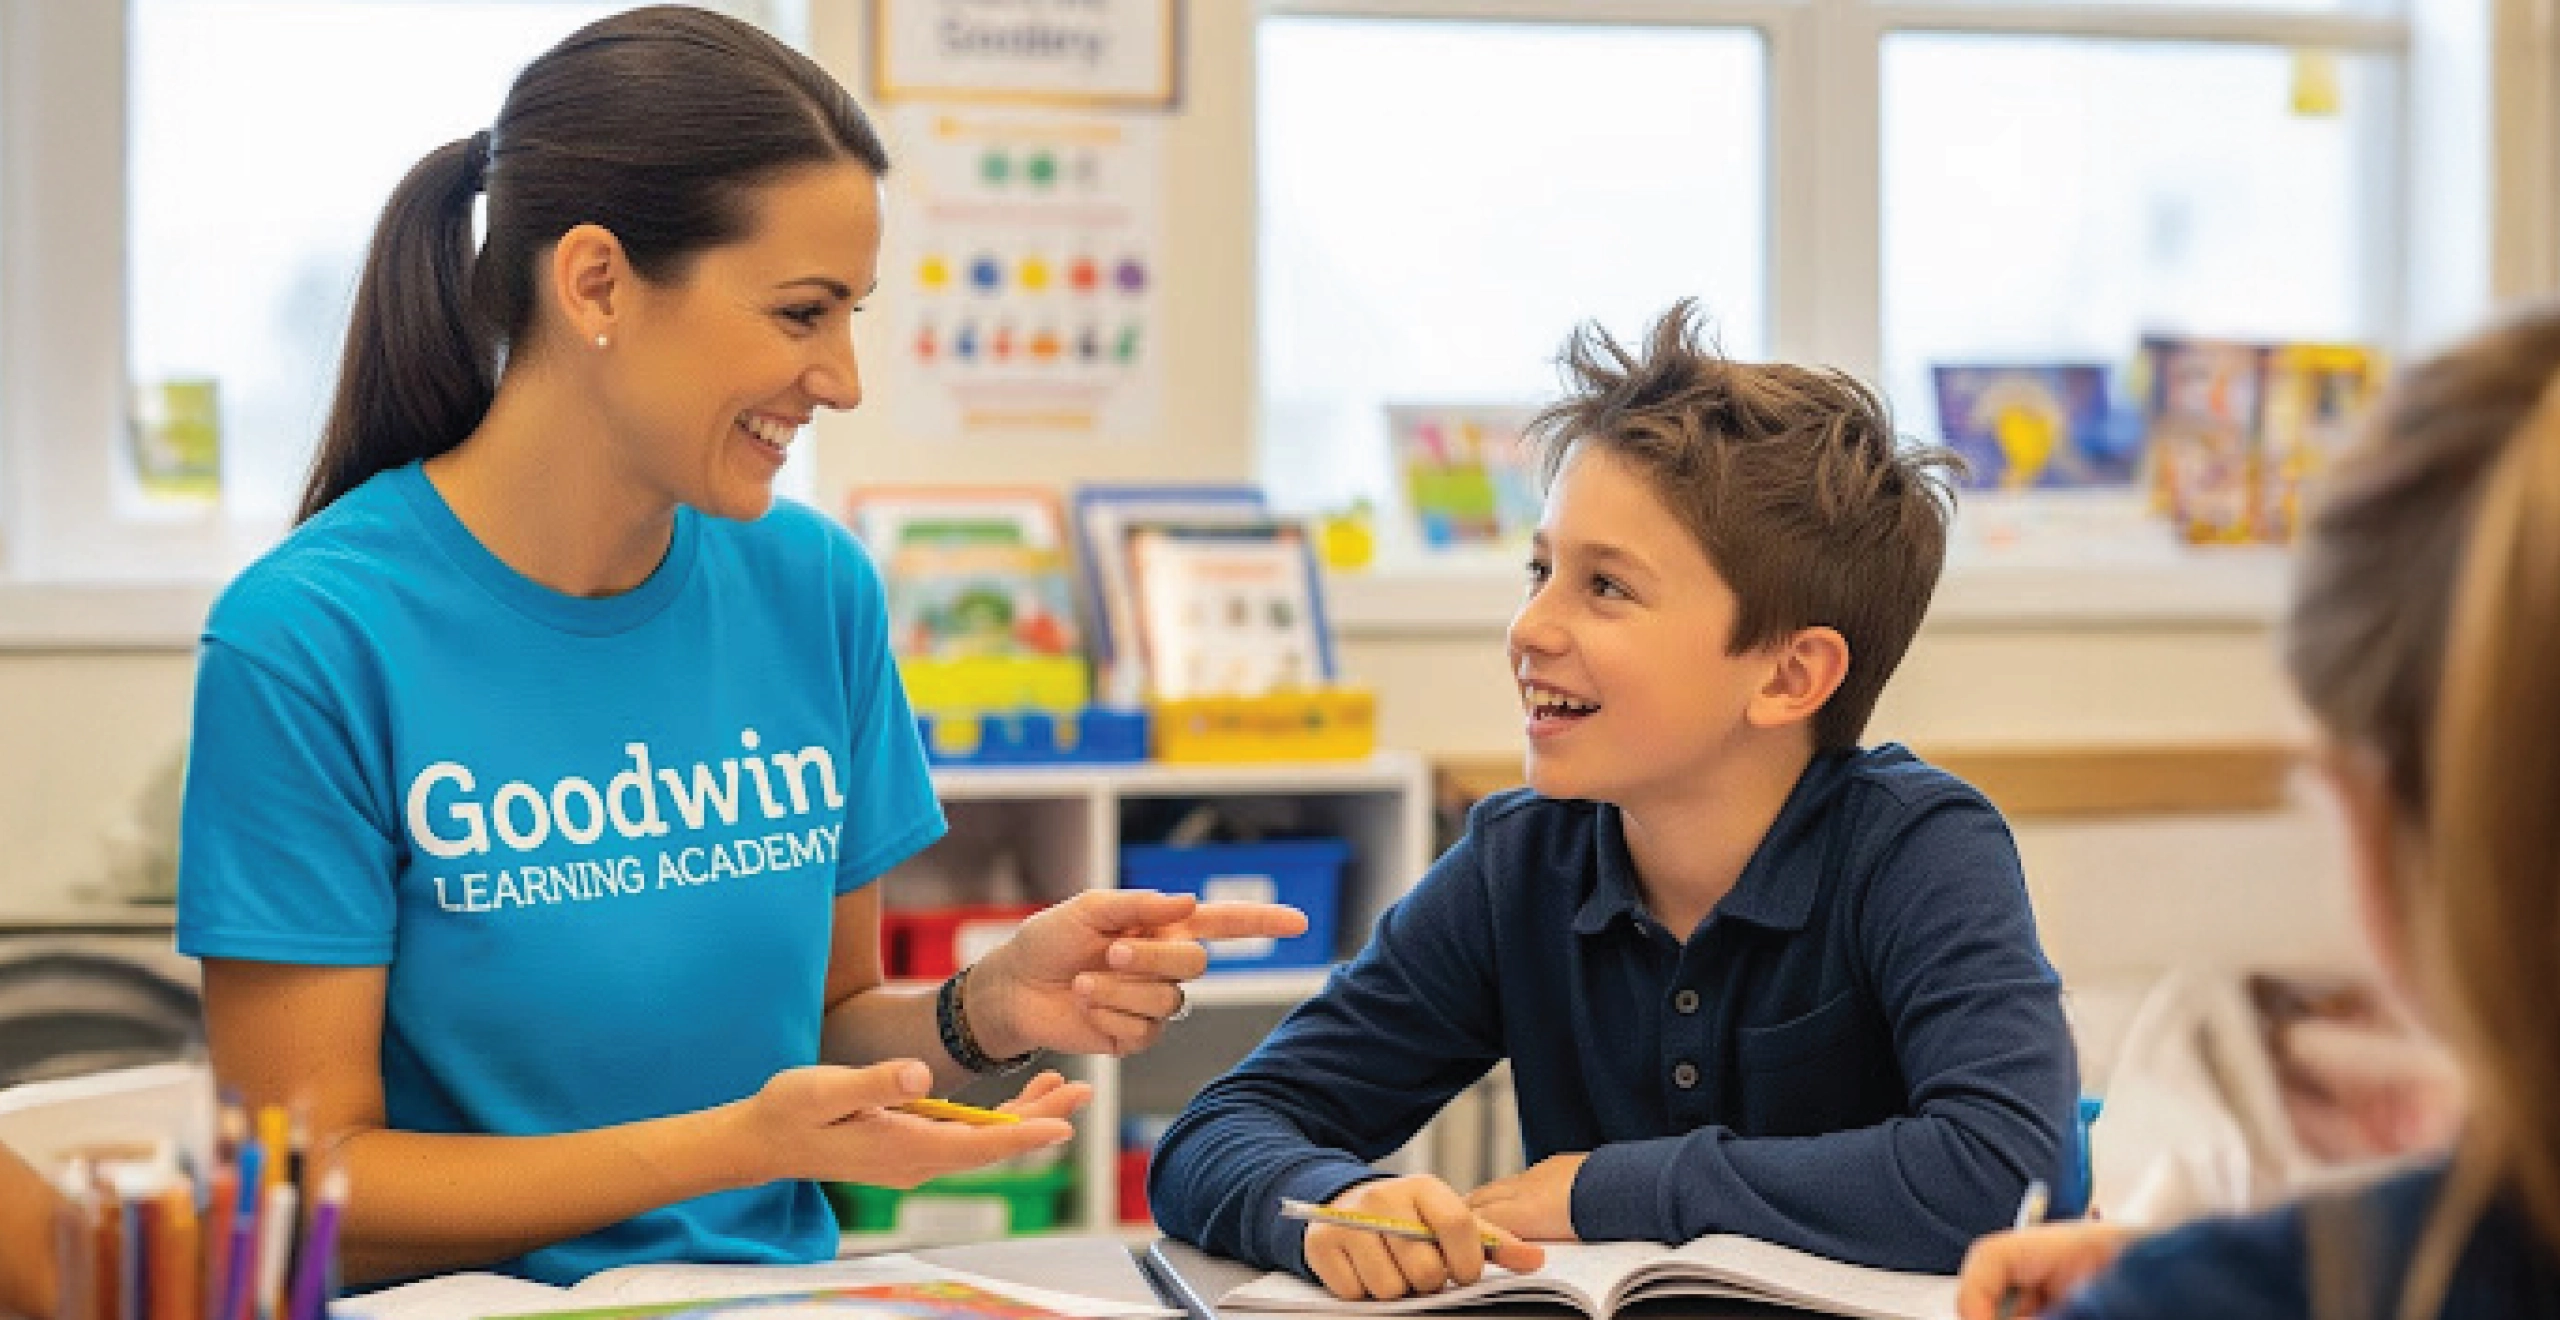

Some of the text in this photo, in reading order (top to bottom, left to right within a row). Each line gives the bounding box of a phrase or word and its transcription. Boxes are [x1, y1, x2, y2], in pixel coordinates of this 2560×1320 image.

[407, 728, 844, 858] Goodwin
[434, 823, 843, 912] LEARNING ACADEMY
